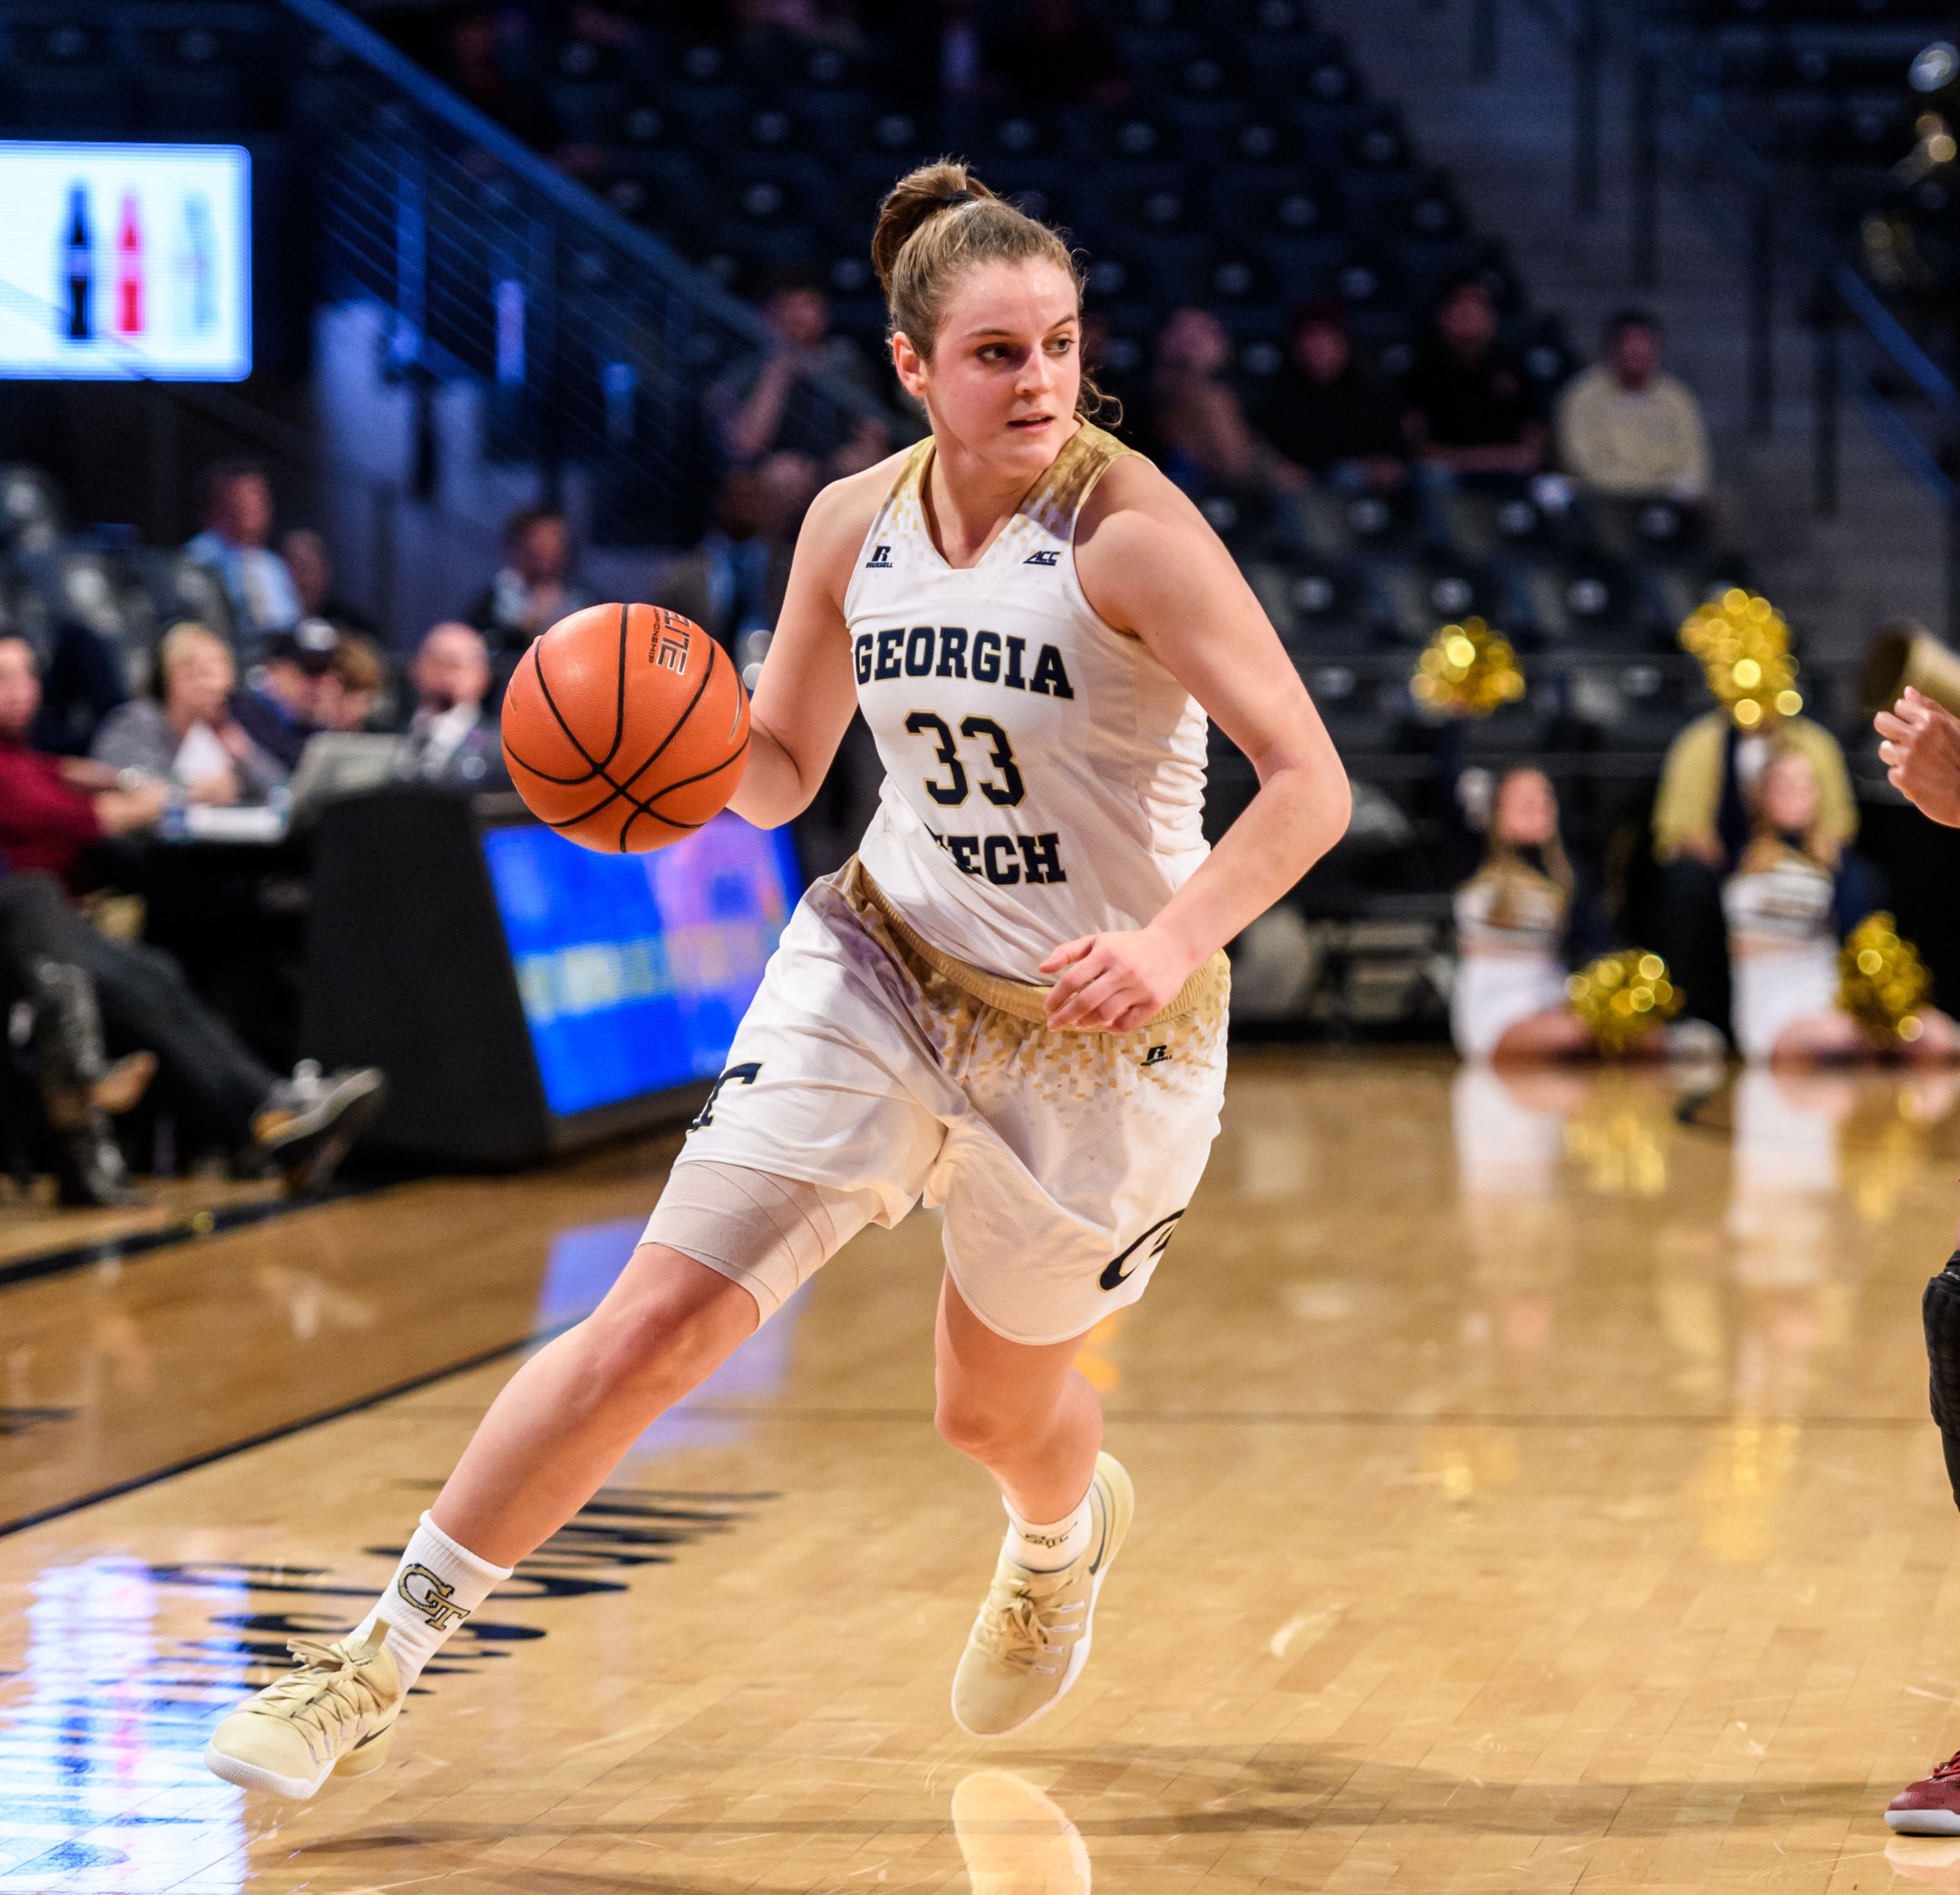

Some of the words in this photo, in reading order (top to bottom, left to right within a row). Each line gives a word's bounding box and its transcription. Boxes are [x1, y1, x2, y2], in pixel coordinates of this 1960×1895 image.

[1022, 550, 1061, 565] ACC
[855, 626, 1075, 700] GEORGIA
[903, 709, 1028, 808] 33
[933, 832, 1068, 886] ECH
[397, 1562, 471, 1632] GT
